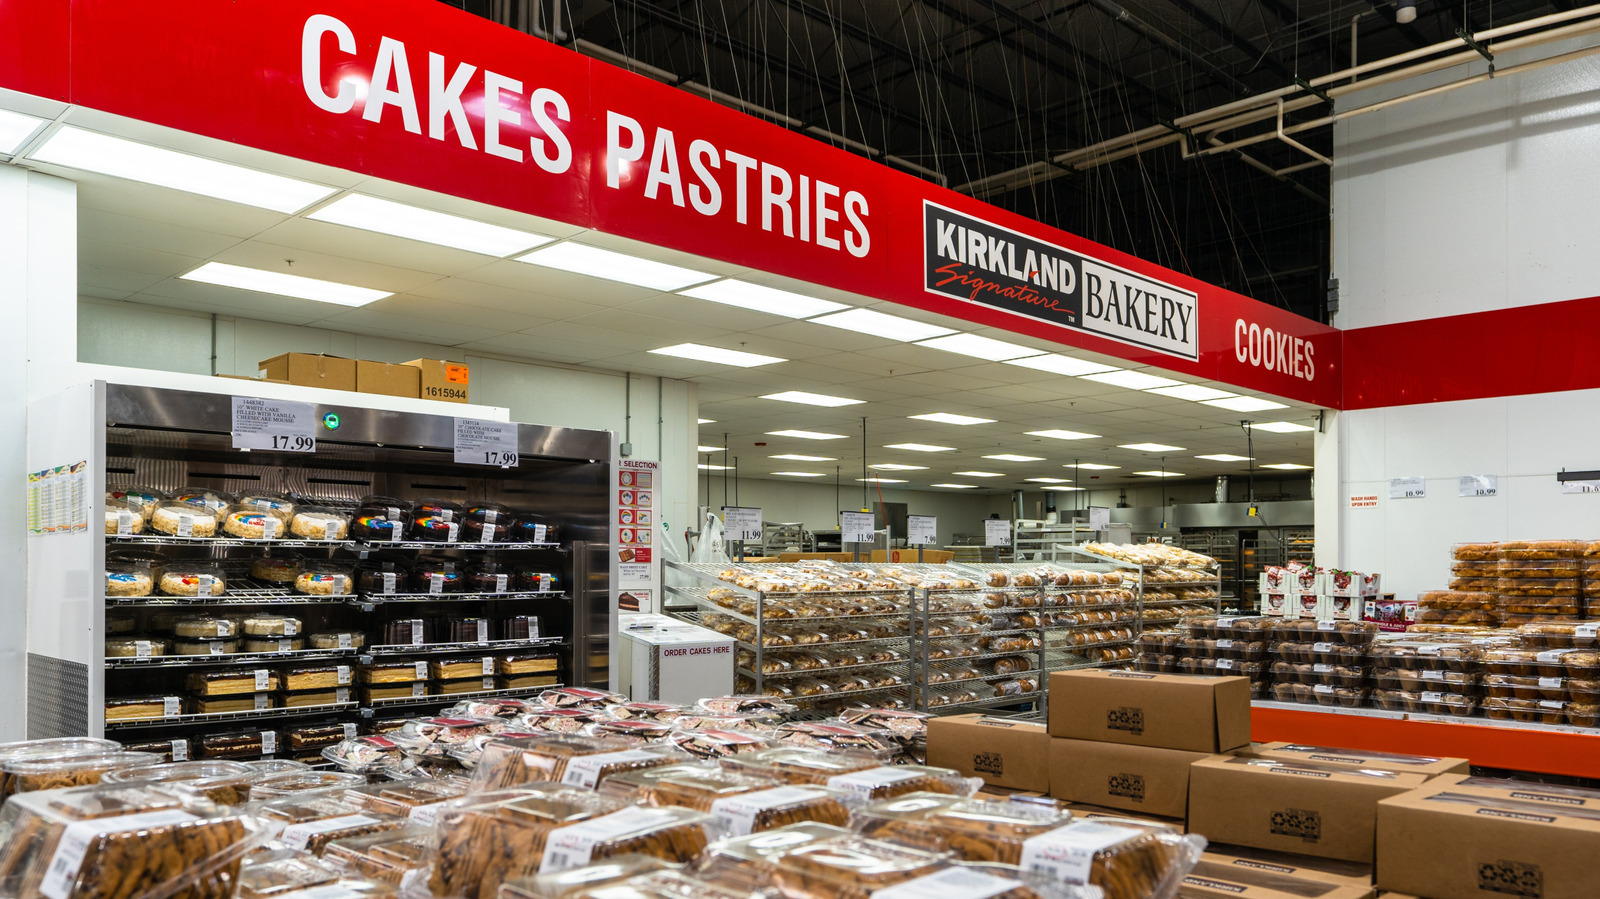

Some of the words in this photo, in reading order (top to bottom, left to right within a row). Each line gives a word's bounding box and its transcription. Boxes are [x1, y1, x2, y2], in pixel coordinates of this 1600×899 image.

[302, 13, 573, 174] CAKES
[606, 109, 871, 259] PASTRIES
[936, 218, 1077, 295] KIRKLAND
[934, 262, 1076, 315] Signature
[1085, 271, 1193, 344] BAKERY
[1234, 318, 1315, 382] COOKIES
[425, 386, 467, 400] 1615944
[272, 435, 314, 451] 17.99
[484, 451, 517, 466] 17.99
[623, 460, 658, 469] SELECTION
[1475, 488, 1496, 496] 10.99
[741, 530, 761, 540] 11.99
[857, 533, 874, 542] 11.99
[924, 535, 936, 544] 7.99
[663, 648, 687, 657] ORDER
[689, 647, 712, 656] CAKES
[713, 646, 730, 654] HERE
